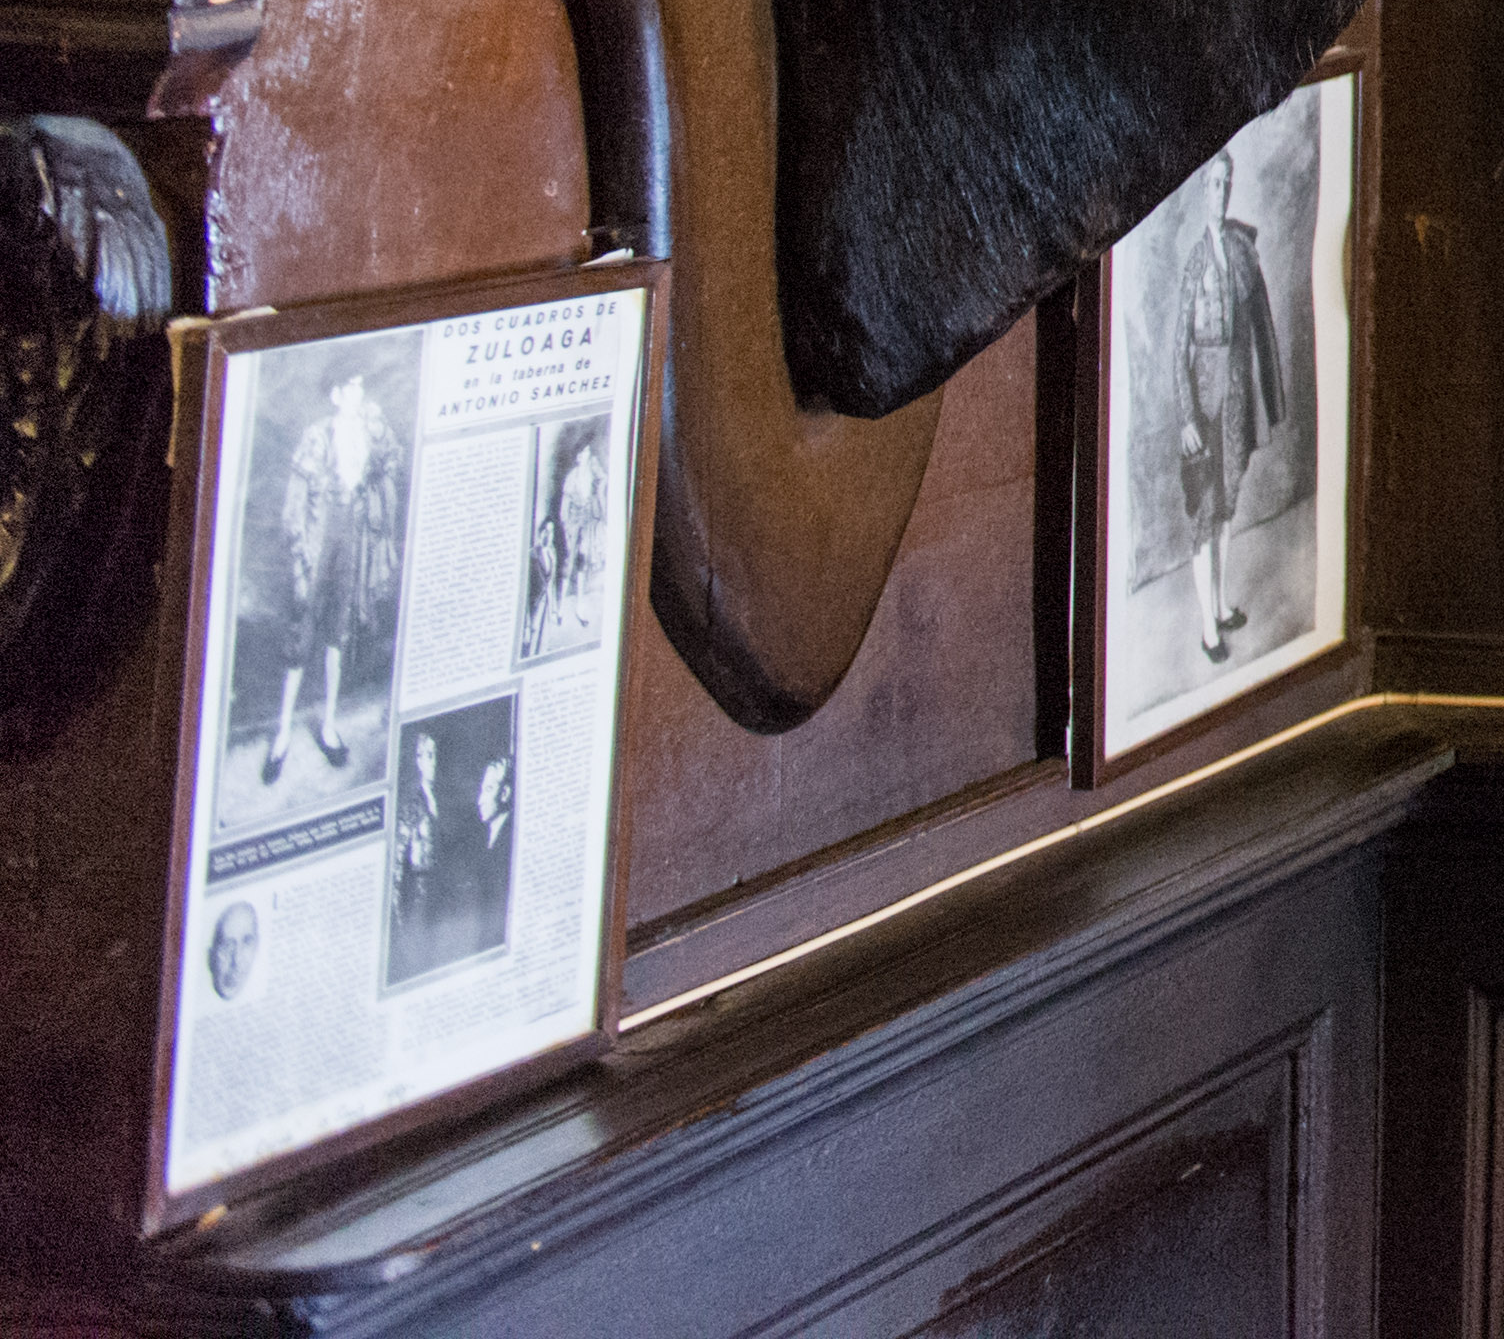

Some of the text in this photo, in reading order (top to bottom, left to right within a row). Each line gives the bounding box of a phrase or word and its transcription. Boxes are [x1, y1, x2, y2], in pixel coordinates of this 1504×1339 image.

[443, 301, 617, 338] DOS CUADROS DE
[466, 327, 592, 364] ZULOAGA
[463, 358, 591, 389] en la taberna de
[438, 375, 611, 417] ANTONIO SANCHEZ
